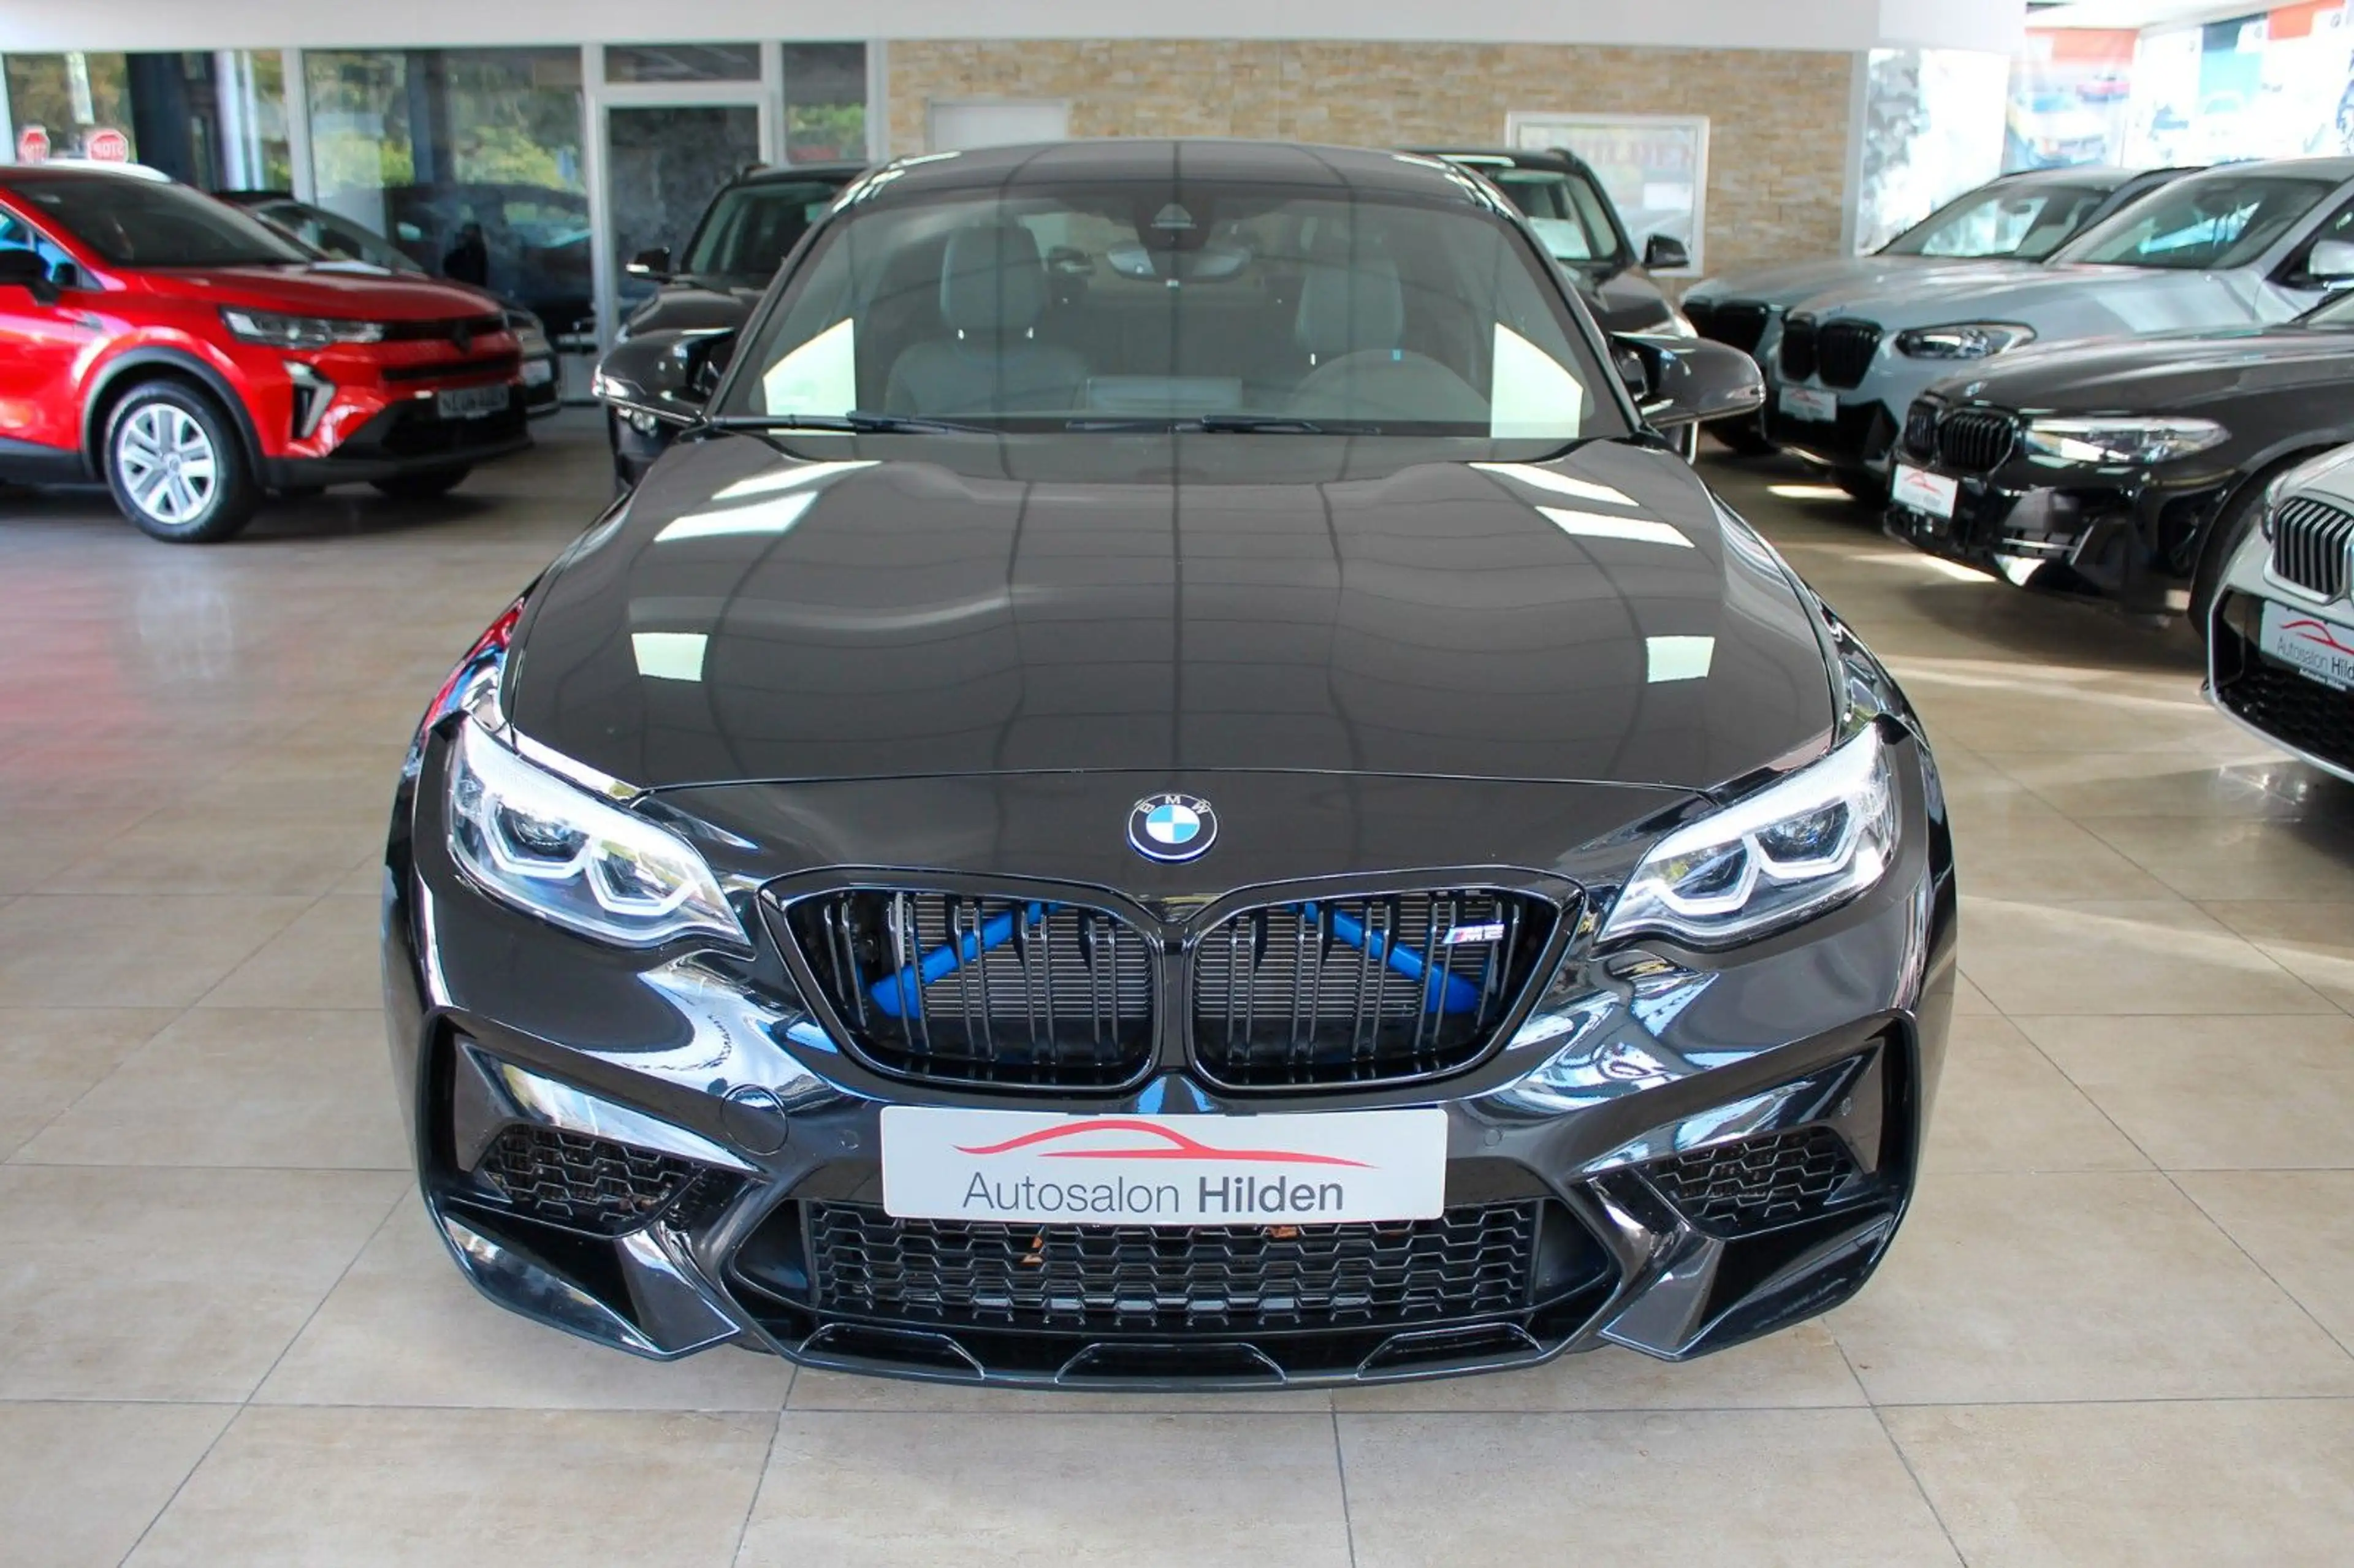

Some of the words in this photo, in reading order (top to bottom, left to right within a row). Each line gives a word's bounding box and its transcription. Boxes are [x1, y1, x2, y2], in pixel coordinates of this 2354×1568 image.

[2276, 634, 2328, 669] Autosalon
[1133, 794, 1212, 815] BMW
[962, 1171, 1179, 1214] Autosalon
[1198, 1175, 1344, 1214] Hilden
